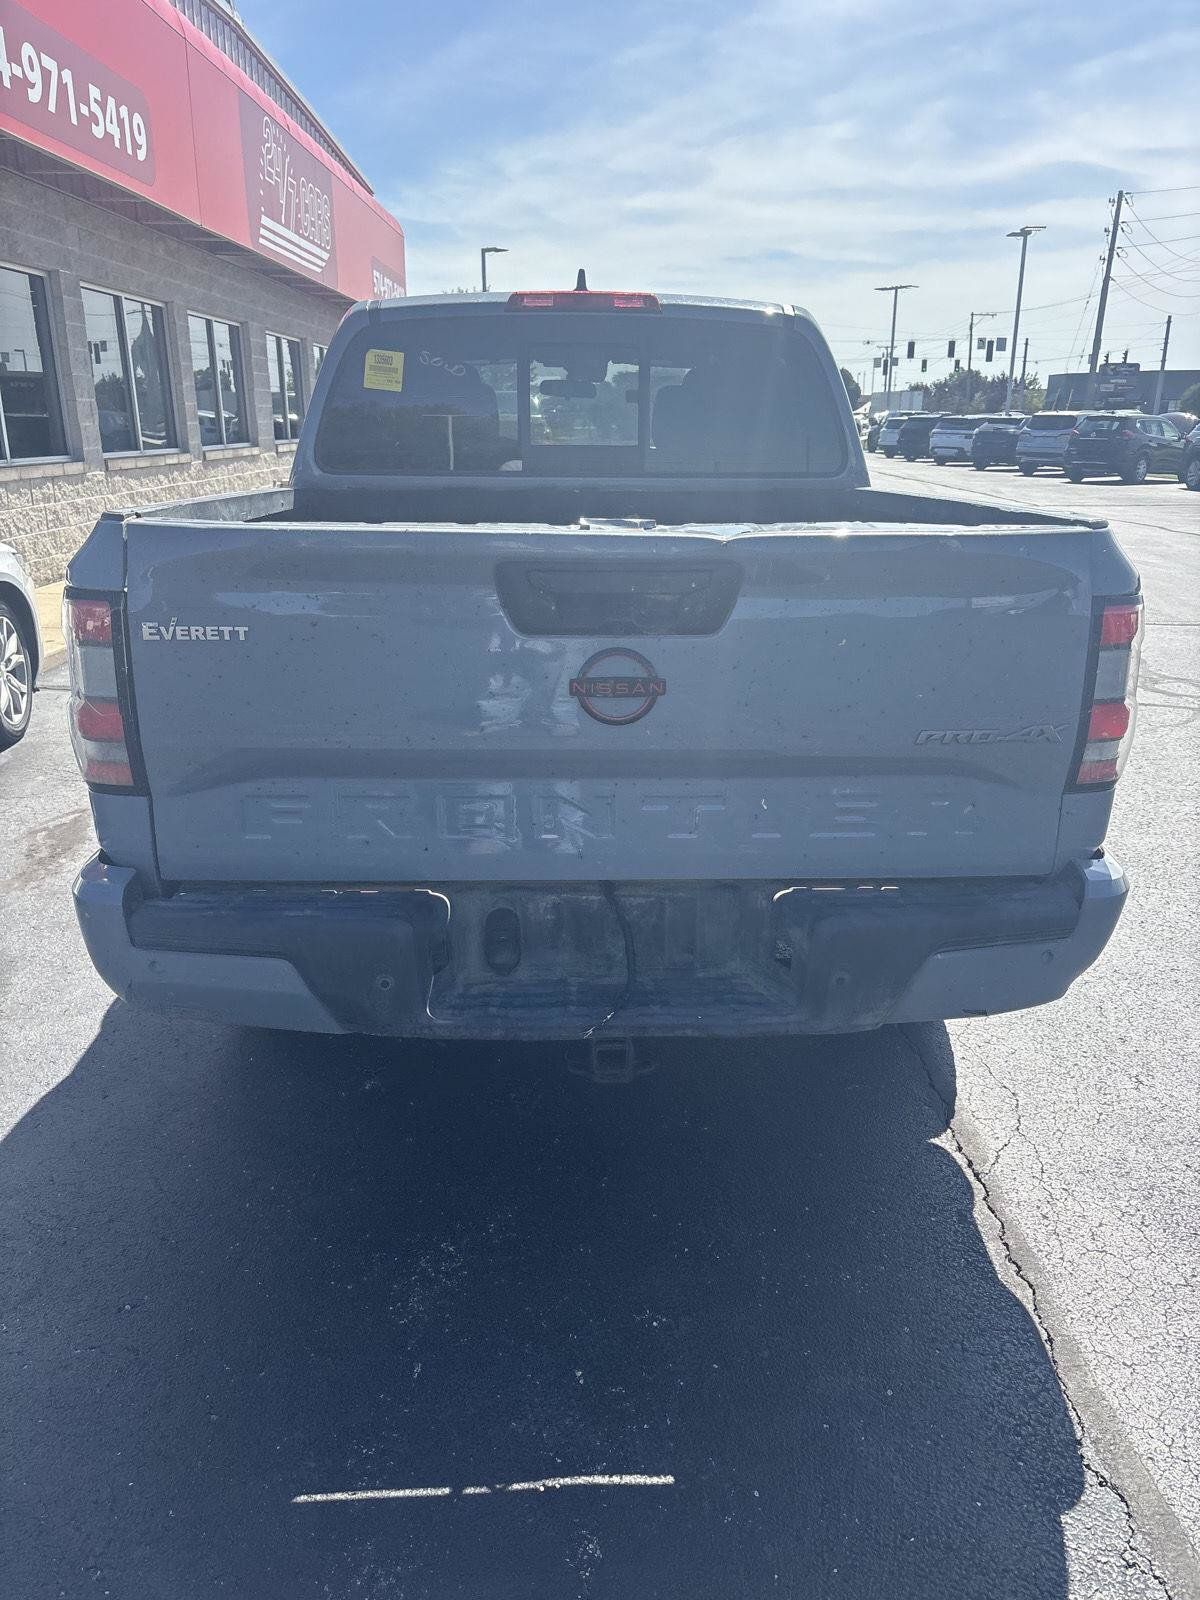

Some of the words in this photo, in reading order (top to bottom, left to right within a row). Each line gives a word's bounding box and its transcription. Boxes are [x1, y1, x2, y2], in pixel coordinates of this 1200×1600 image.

[299, 177, 331, 250] CARS
[141, 617, 249, 641] EVERETT
[572, 681, 664, 695] NISSAN
